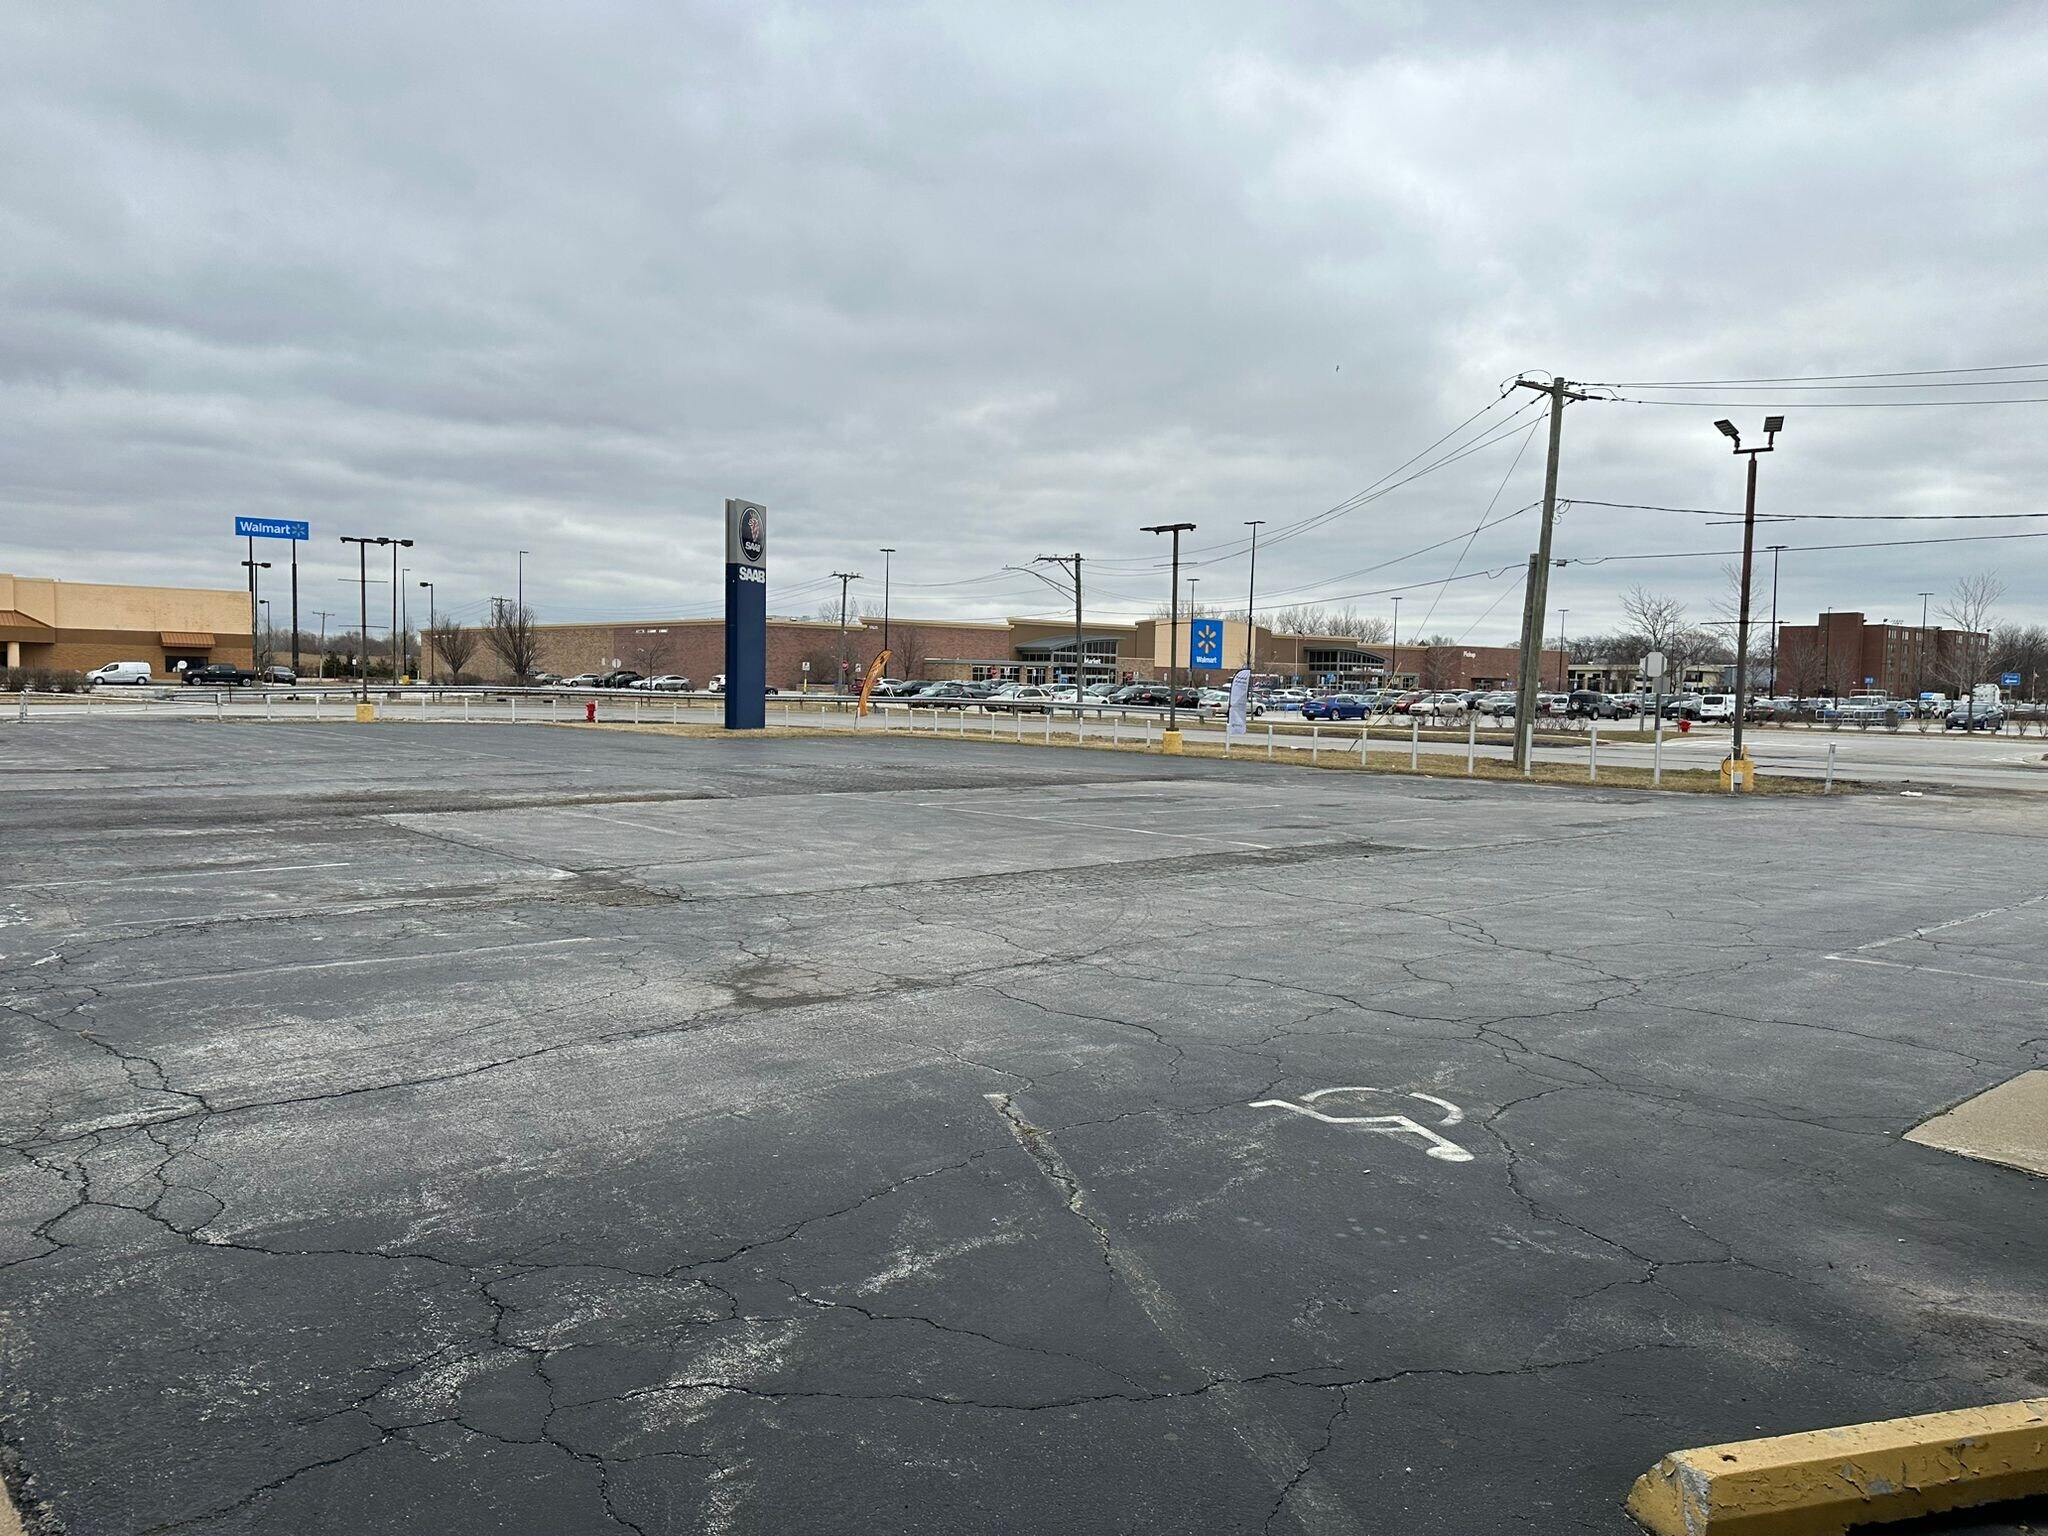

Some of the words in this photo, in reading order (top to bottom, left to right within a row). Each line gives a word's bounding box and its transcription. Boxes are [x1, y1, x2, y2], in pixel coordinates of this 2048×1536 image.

[239, 521, 291, 535] Walmart
[739, 566, 766, 584] SAAB
[1196, 656, 1217, 664] Walmart
